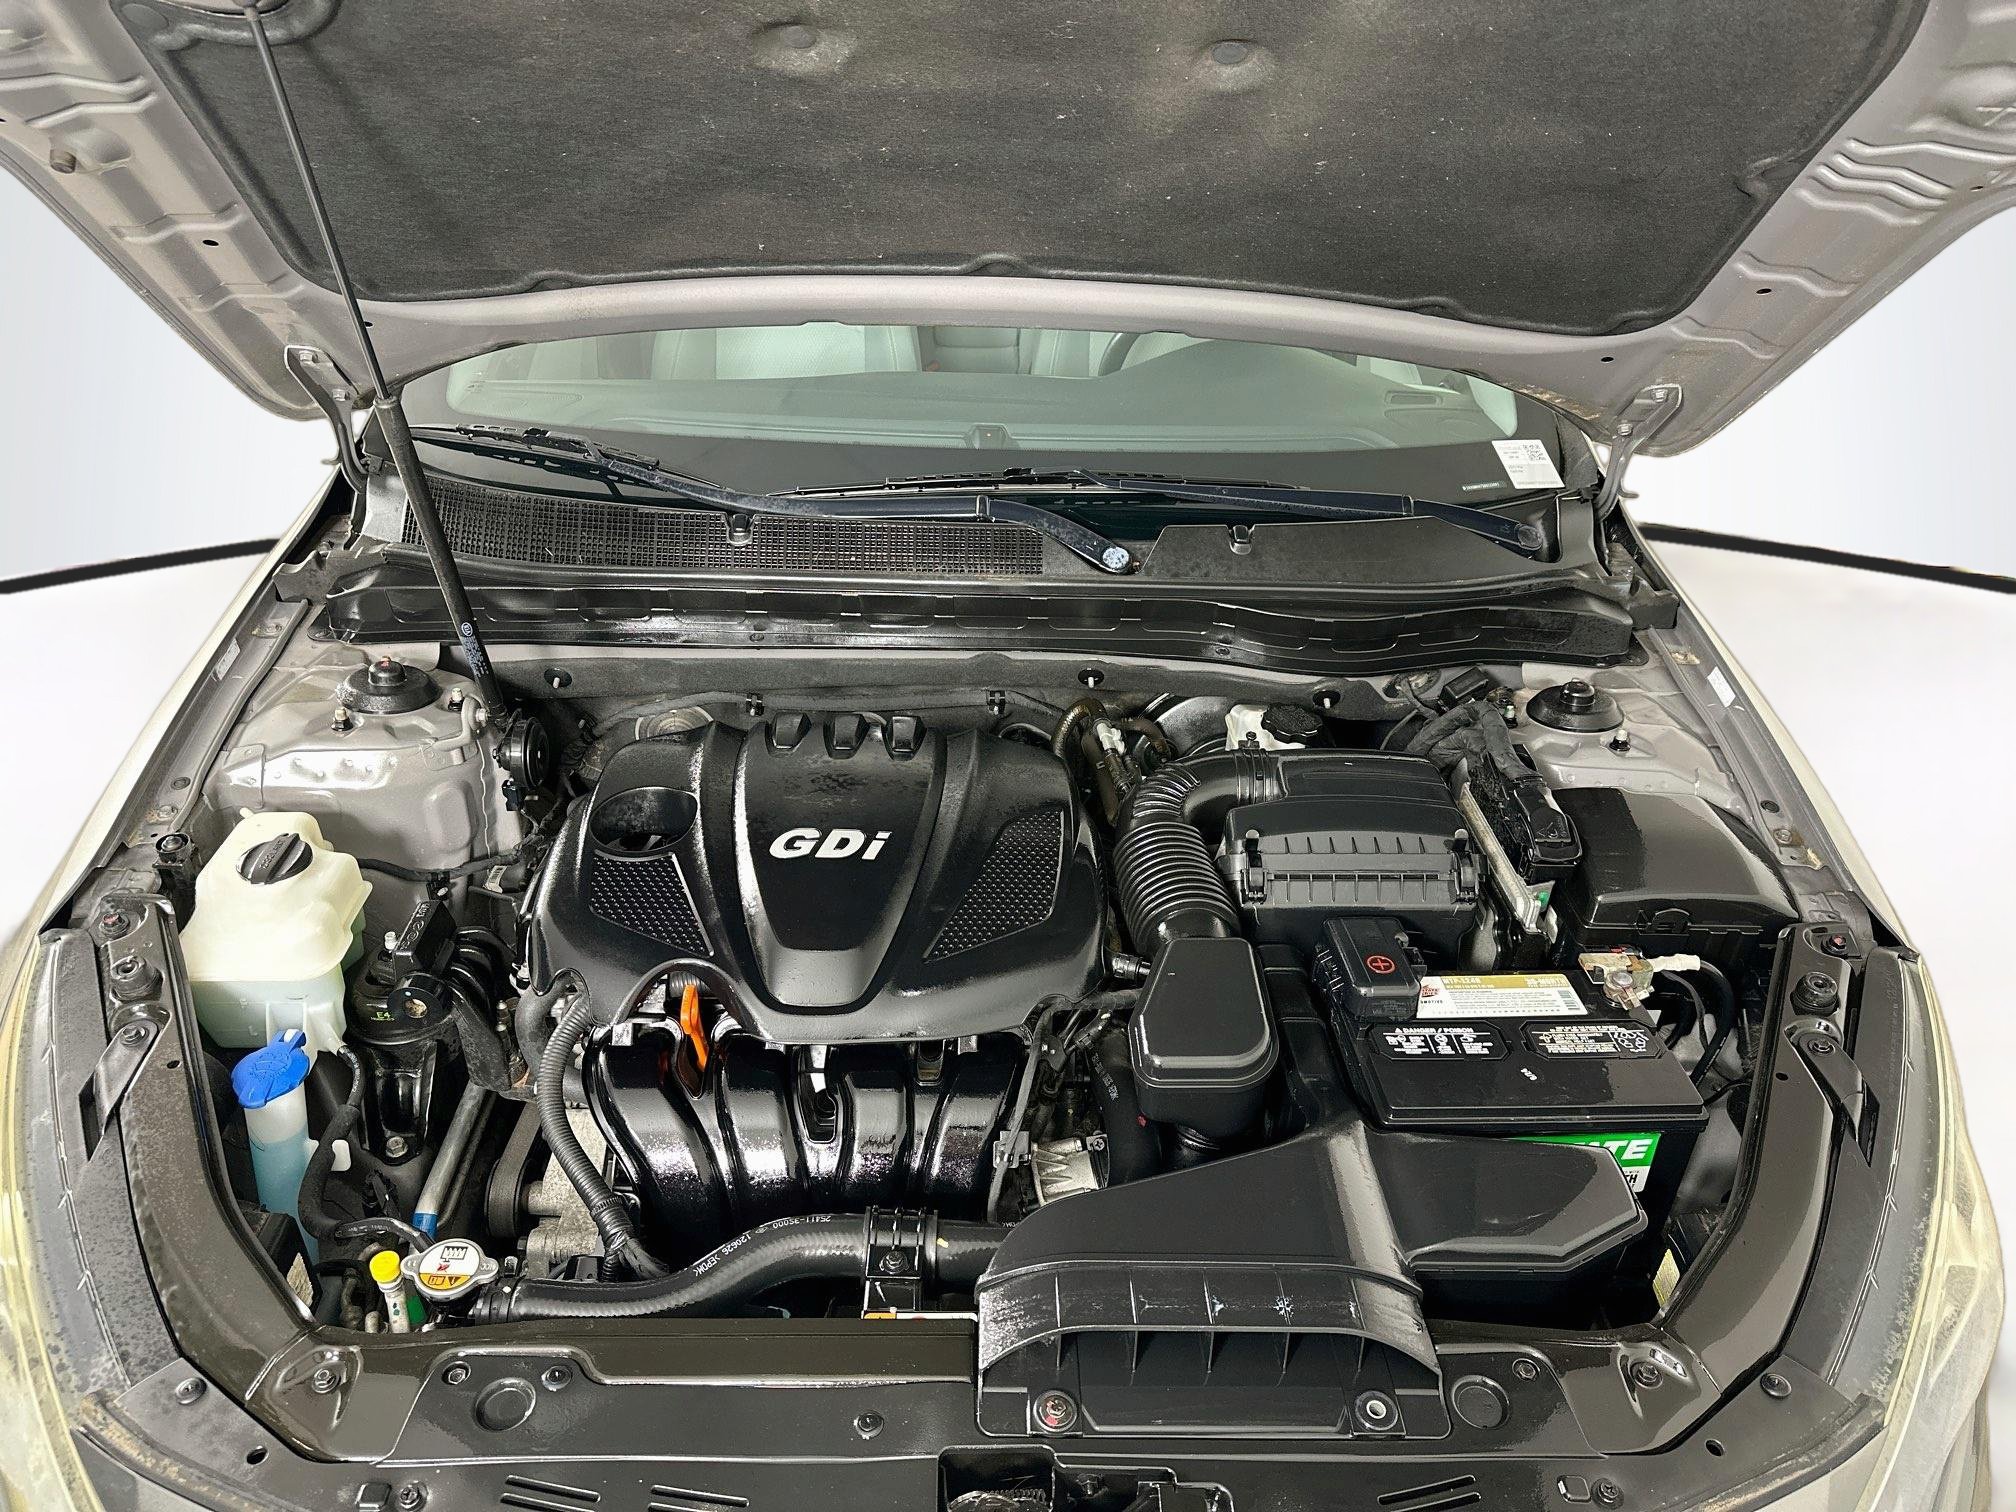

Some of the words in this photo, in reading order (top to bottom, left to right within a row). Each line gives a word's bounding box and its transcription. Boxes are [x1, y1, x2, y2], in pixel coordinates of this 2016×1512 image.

[768, 827, 893, 861] GDi
[772, 1215, 832, 1229] 25411-3S000
[721, 1233, 751, 1256] 120626
